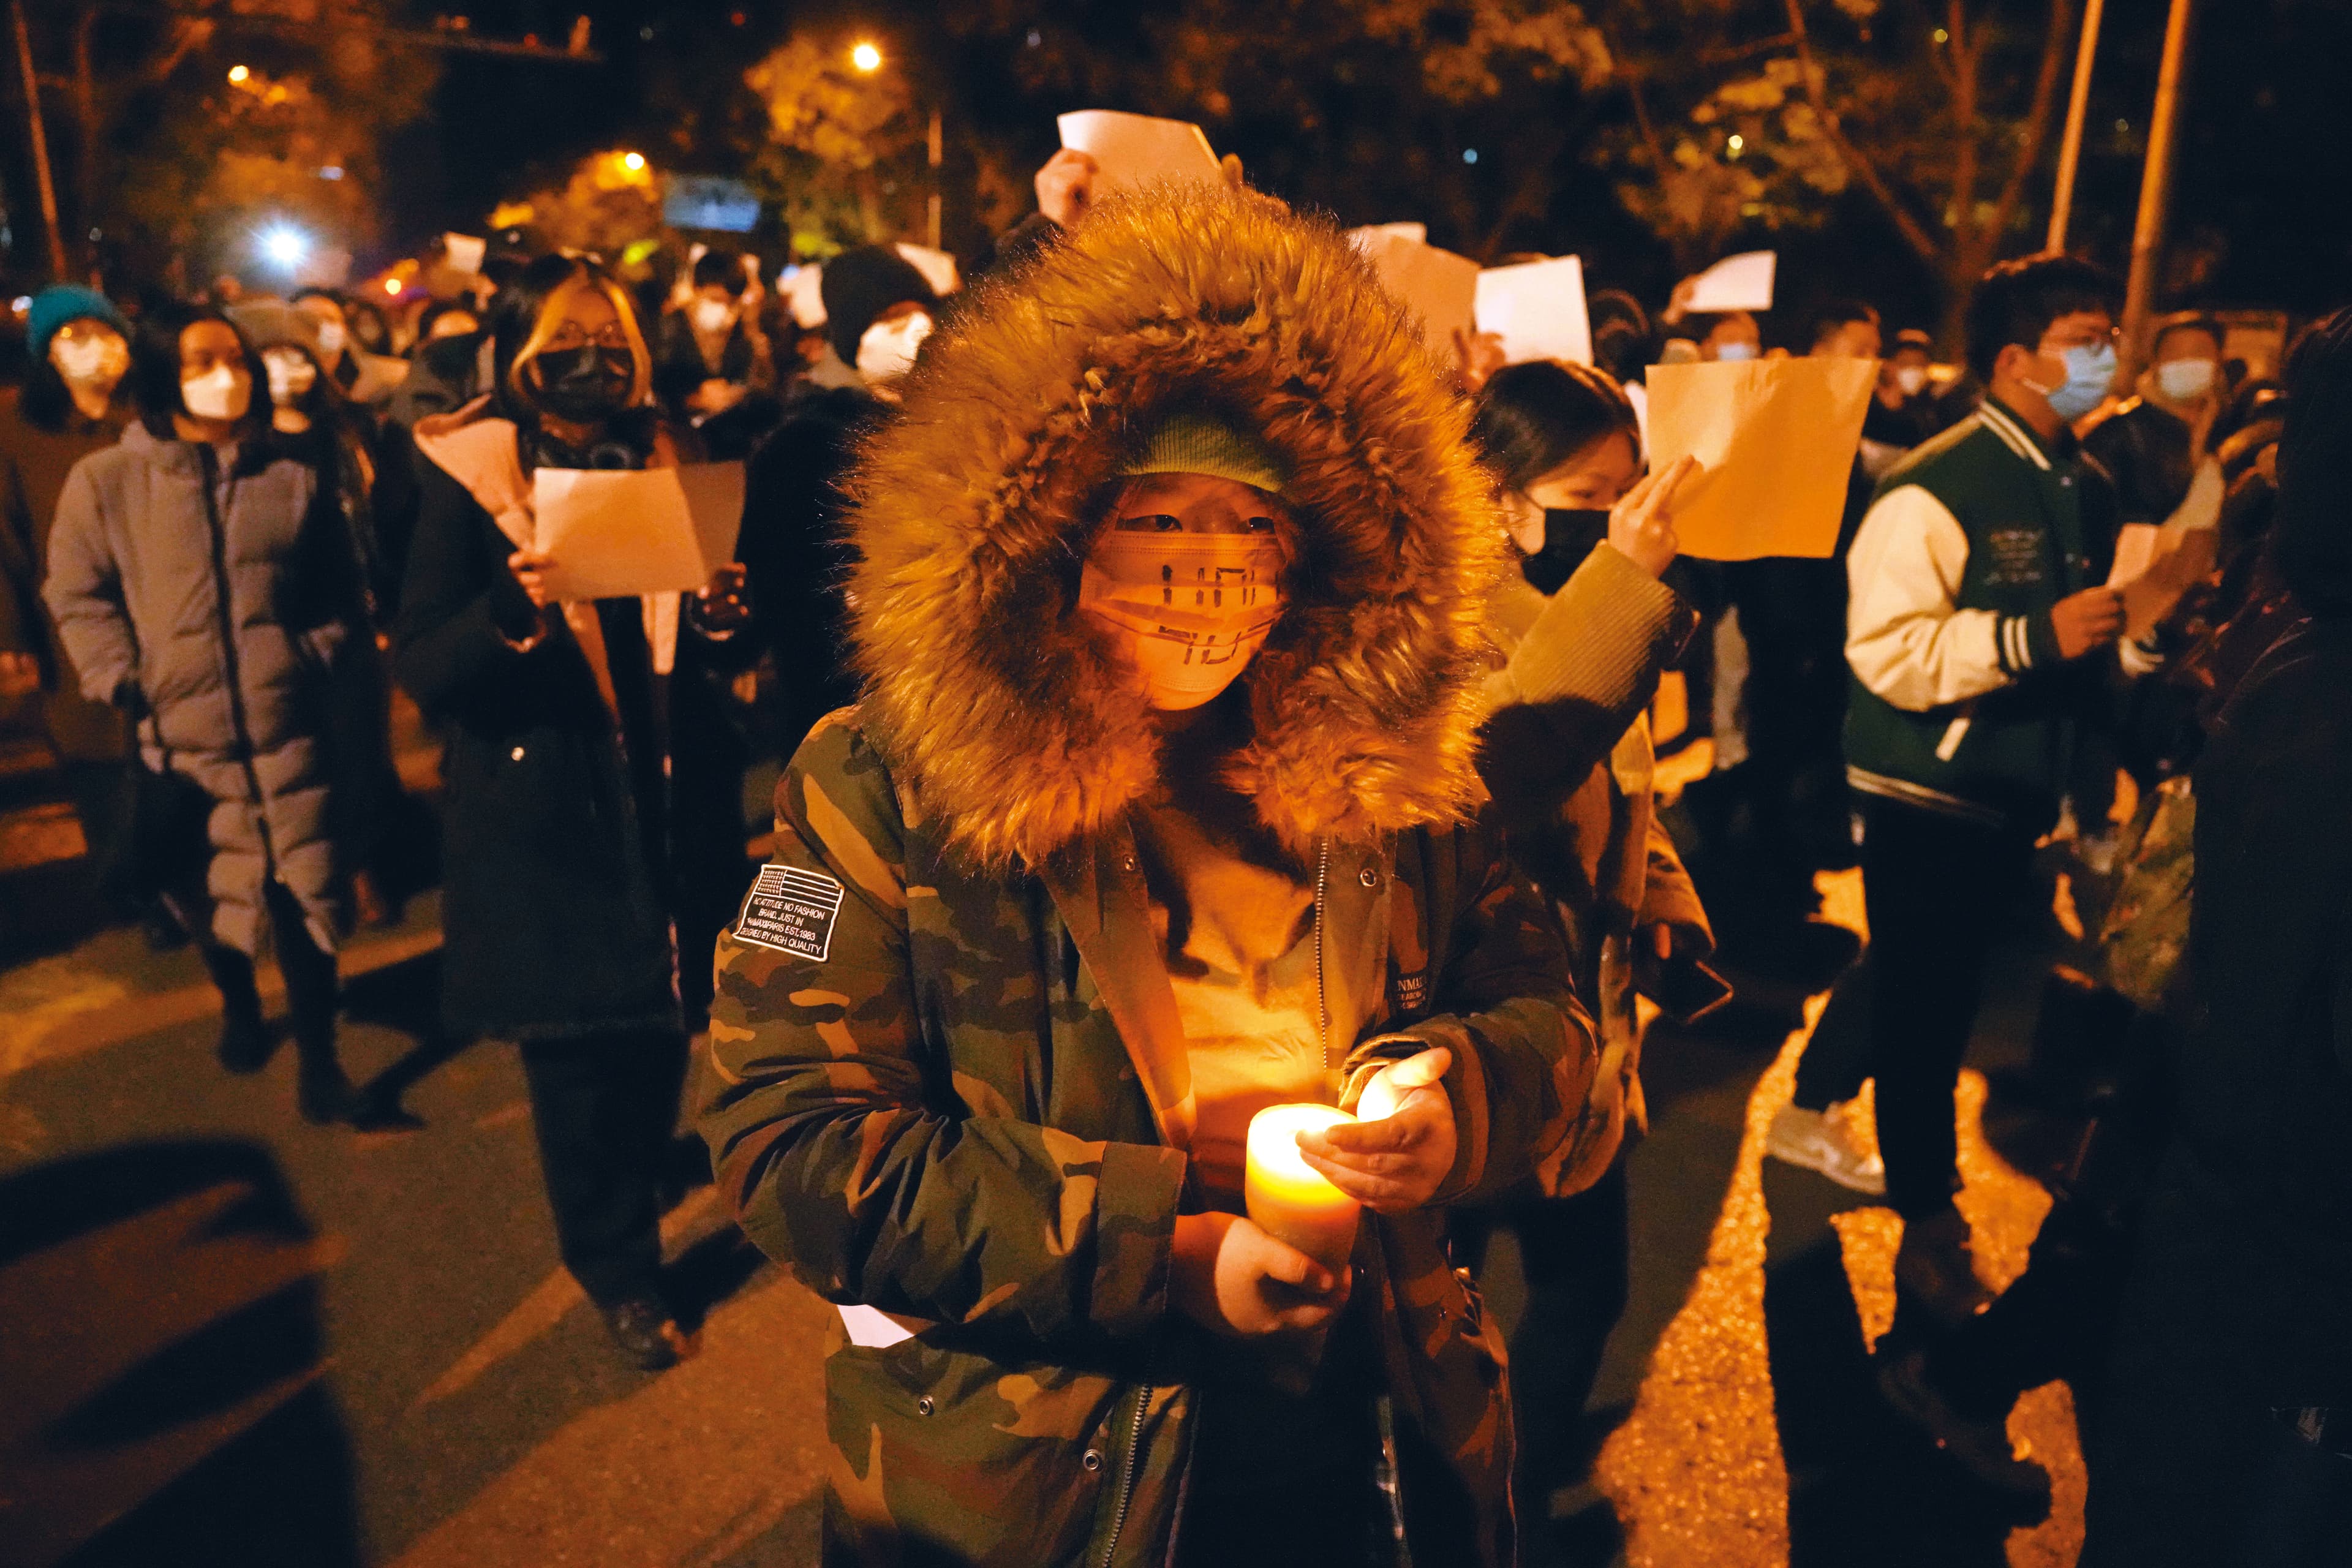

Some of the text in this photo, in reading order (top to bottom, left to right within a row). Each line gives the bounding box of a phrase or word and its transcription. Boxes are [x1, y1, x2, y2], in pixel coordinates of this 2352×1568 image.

[778, 913, 795, 924] JUST
[795, 917, 804, 927] IN
[783, 902, 794, 912] NO
[794, 905, 825, 920] FASHION
[761, 931, 771, 941] BY
[770, 933, 788, 946] HIGH
[788, 938, 822, 955] QUALITY
